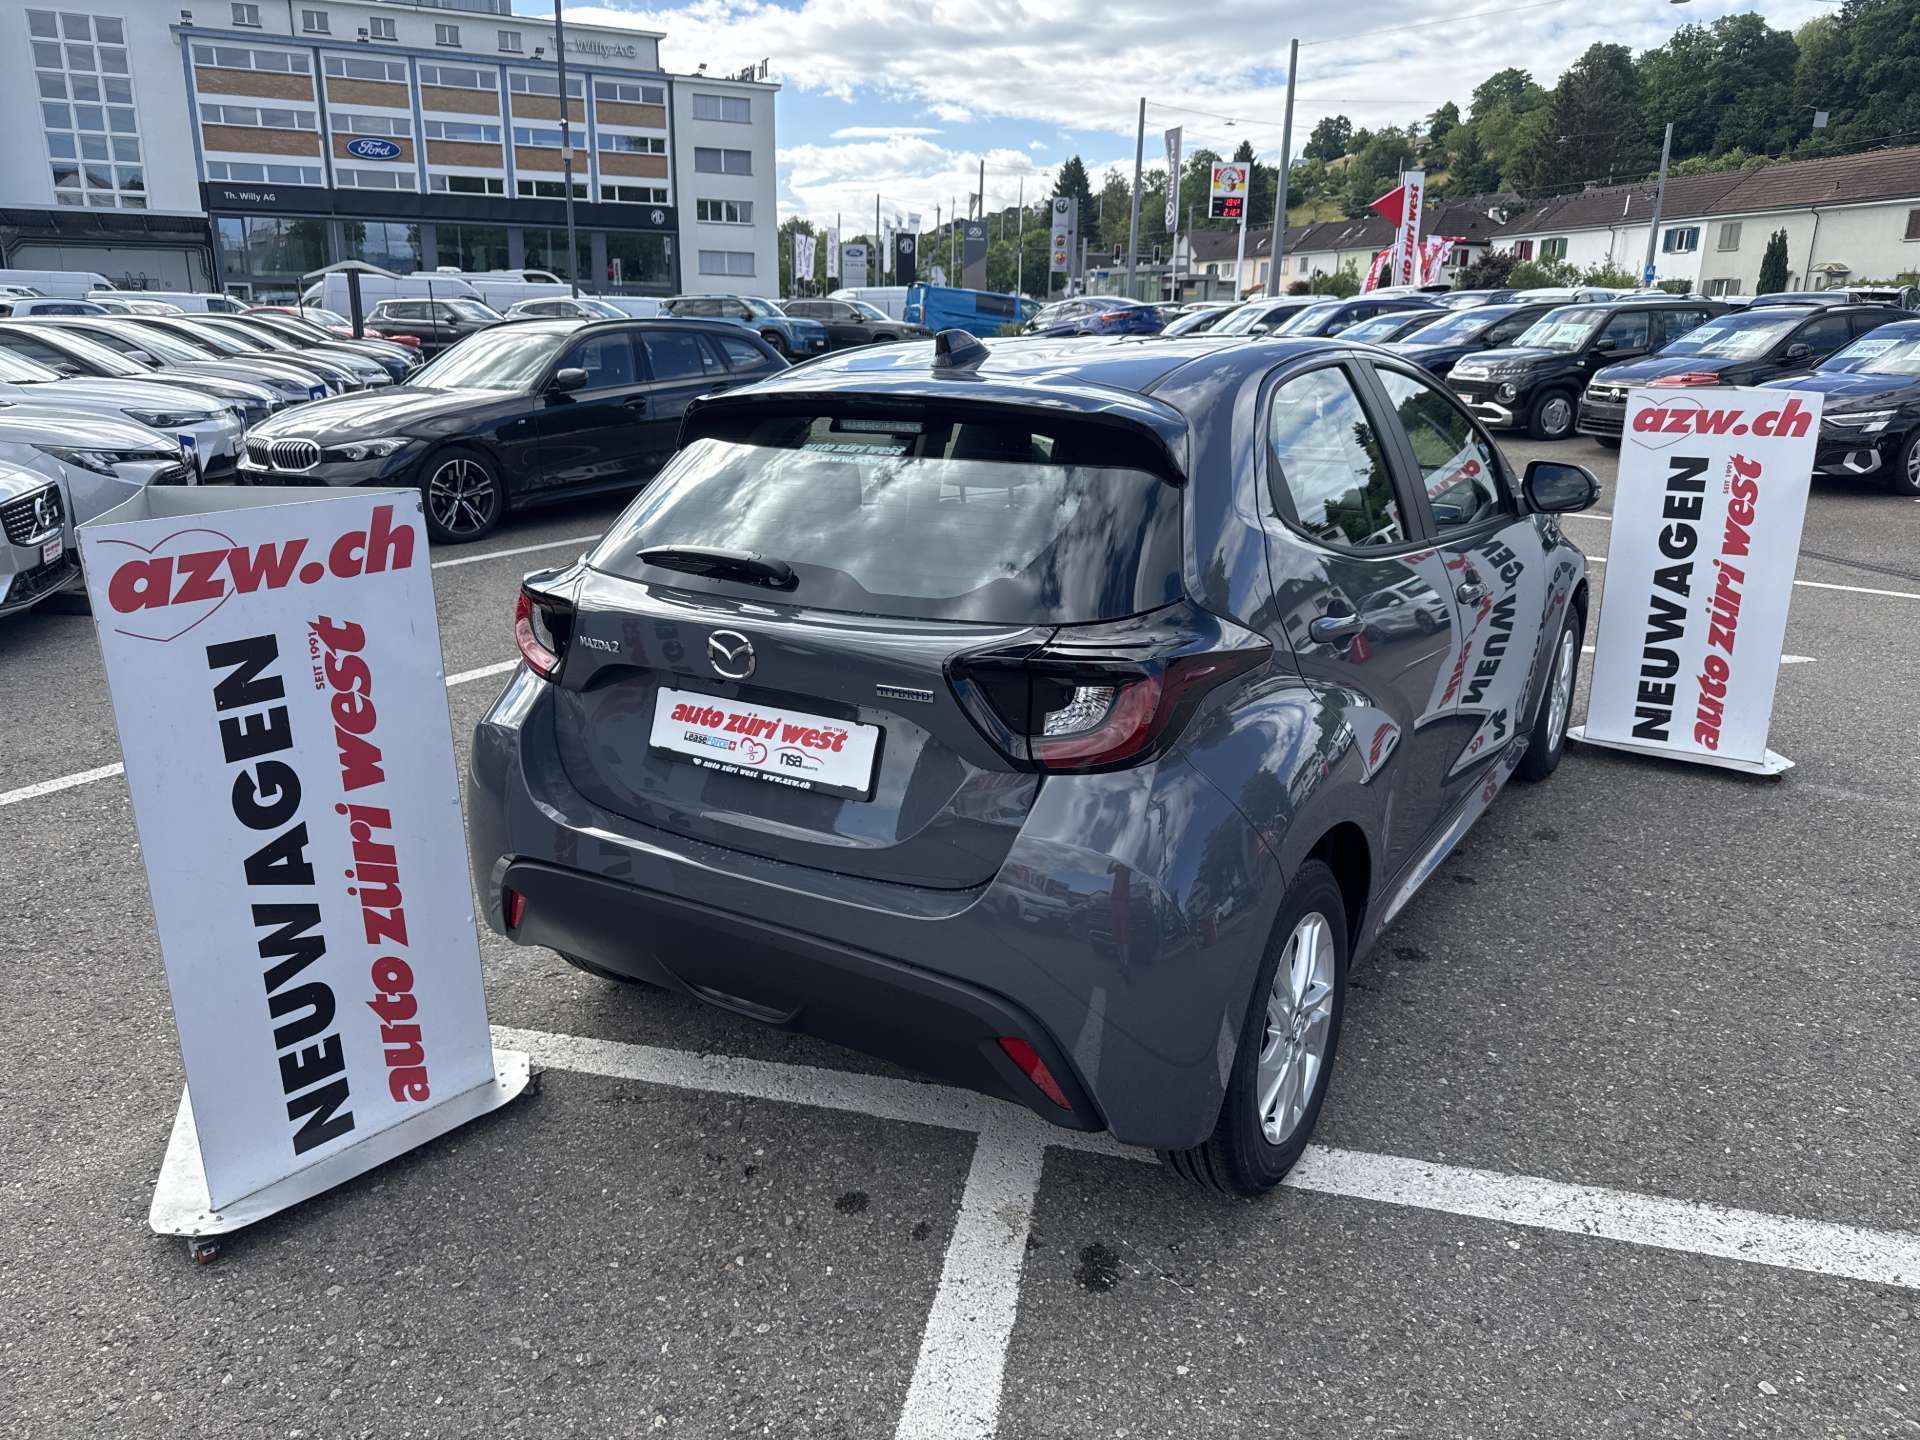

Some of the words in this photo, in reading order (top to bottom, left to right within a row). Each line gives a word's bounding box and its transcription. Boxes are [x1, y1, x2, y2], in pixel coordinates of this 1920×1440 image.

[576, 39, 611, 58] Willy
[614, 43, 638, 58] AG
[357, 139, 391, 157] Ford
[224, 191, 238, 200] Th.
[239, 192, 261, 202] Willy
[263, 193, 276, 202] AG
[1408, 183, 1419, 221] west
[1632, 398, 1813, 437] azw.ch
[1721, 453, 1763, 556] west
[1723, 480, 1731, 495] SEIT
[108, 505, 415, 613] azw.ch
[1631, 456, 1710, 742] NEUWAGEN
[1705, 558, 1745, 656] züri
[308, 630, 321, 662] 1991
[314, 664, 326, 690] SEIT
[306, 614, 386, 793] west
[1693, 654, 1730, 751] auto
[671, 703, 725, 729] auto
[723, 712, 782, 740] züri
[781, 724, 849, 752] west
[703, 760, 720, 769] auto
[740, 768, 759, 778] west
[780, 753, 802, 768] nsa
[206, 633, 355, 1156] NEUWAGEN
[334, 802, 410, 947] züri
[366, 956, 431, 1103] auto
